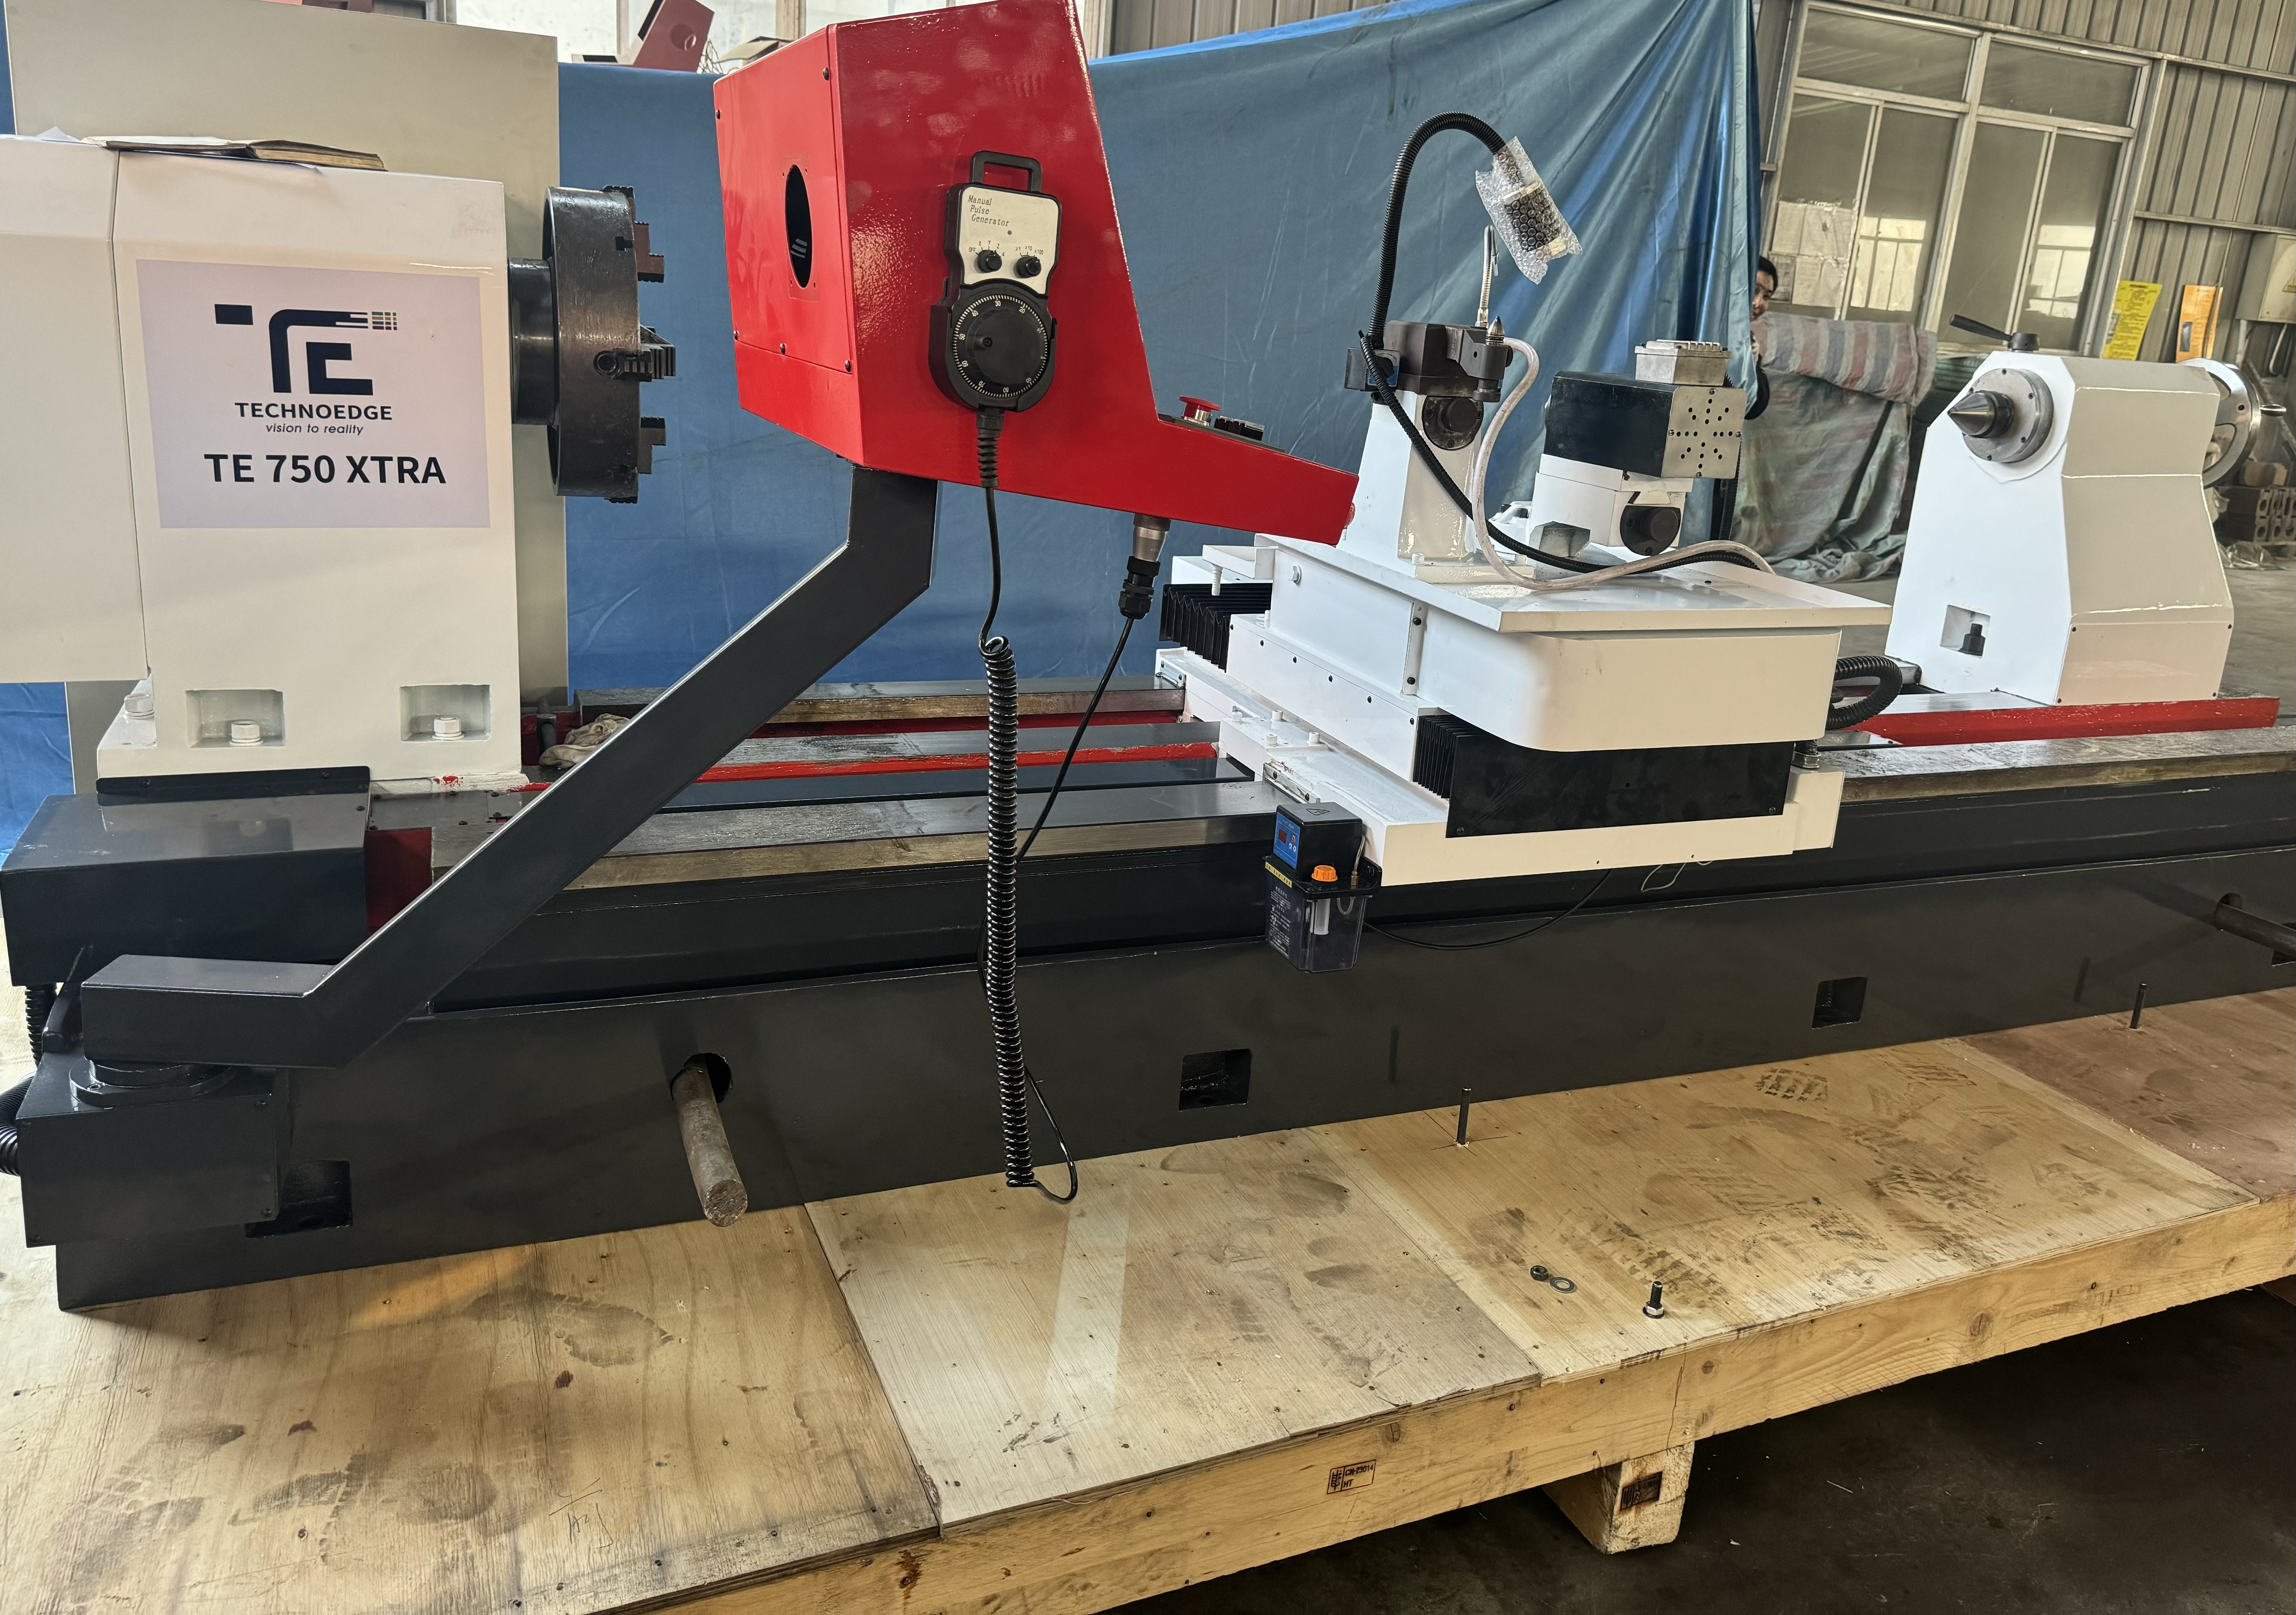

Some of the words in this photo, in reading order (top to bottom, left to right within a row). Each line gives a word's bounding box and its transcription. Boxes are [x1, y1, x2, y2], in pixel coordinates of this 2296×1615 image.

[968, 195, 992, 206] Manual
[970, 205, 990, 214] Pulse
[971, 214, 1009, 227] Generator
[235, 403, 392, 420] TECHNOEDGE
[266, 423, 302, 433] vision
[307, 424, 319, 434] to
[324, 423, 364, 436] reality
[204, 454, 255, 482] TE
[266, 455, 335, 483] 750
[346, 456, 446, 484] XTRA
[1343, 1478, 1354, 1488] HT
